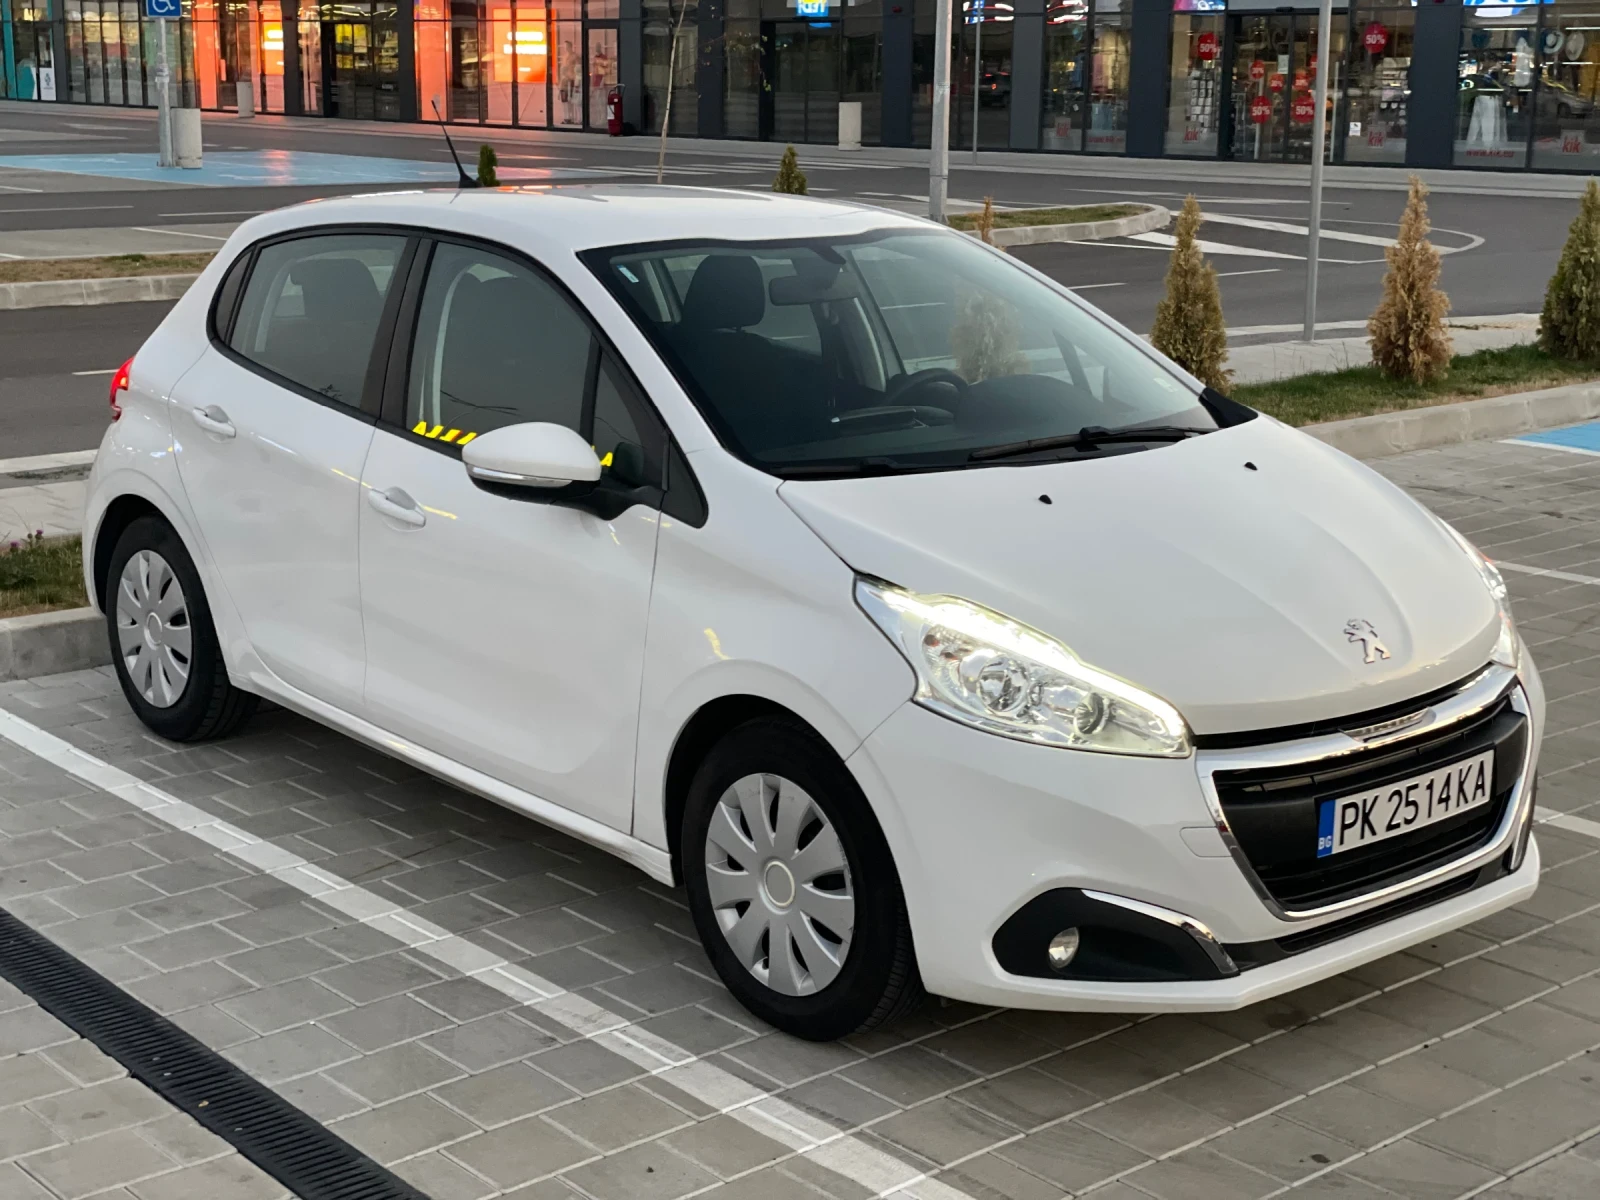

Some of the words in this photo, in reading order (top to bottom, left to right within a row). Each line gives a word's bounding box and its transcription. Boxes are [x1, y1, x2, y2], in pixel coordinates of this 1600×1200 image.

[1366, 34, 1385, 45] 50%
[1200, 43, 1218, 53] 50%
[1252, 105, 1270, 116] 50%
[1295, 105, 1314, 115] 50%
[1339, 795, 1380, 846] PK
[1386, 772, 1453, 833] 2514
[1456, 760, 1486, 808] KA
[1318, 835, 1332, 850] BG
